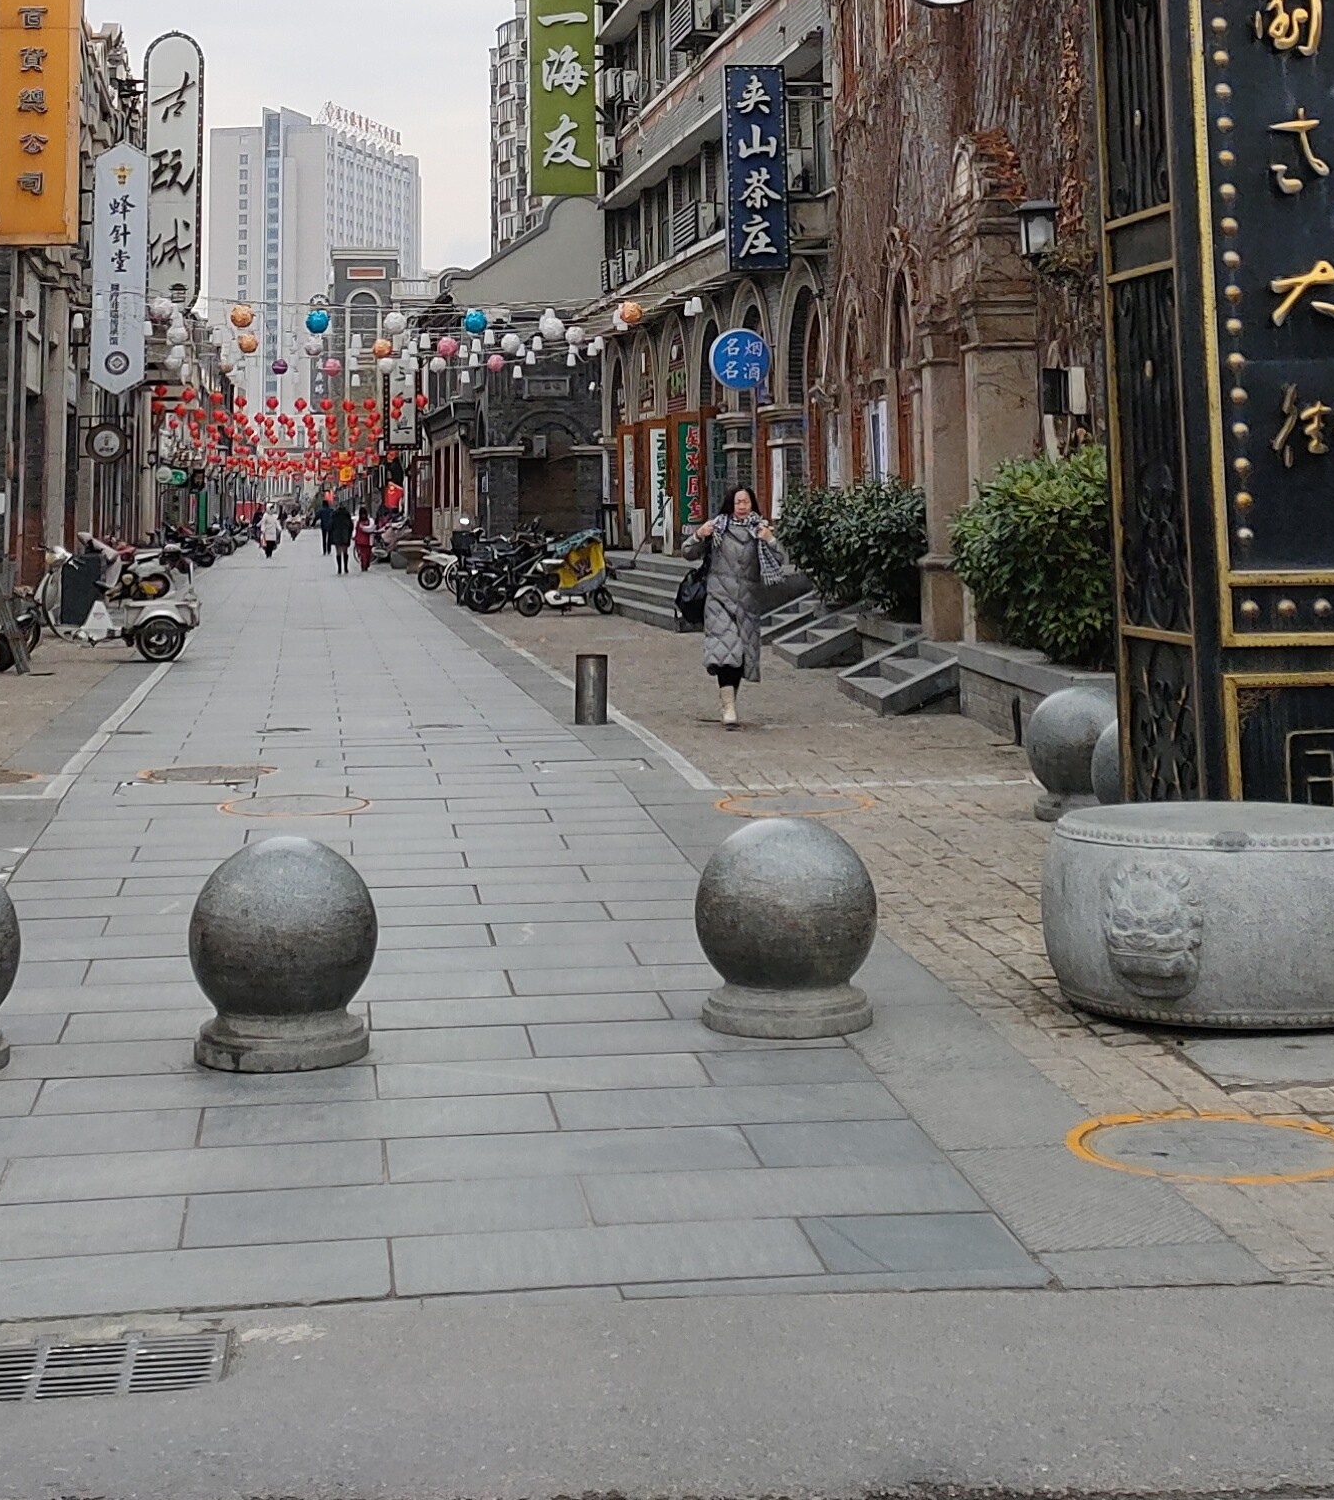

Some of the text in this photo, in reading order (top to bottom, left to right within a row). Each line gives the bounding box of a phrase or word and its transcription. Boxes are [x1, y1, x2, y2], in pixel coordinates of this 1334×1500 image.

[17, 5, 48, 195] 百貨總公司
[151, 71, 196, 270] 古玩城
[734, 74, 782, 259] 夹山茶庄
[108, 193, 136, 273] 蜂針堂
[720, 359, 761, 381] 名酒
[722, 338, 763, 357] 名烟
